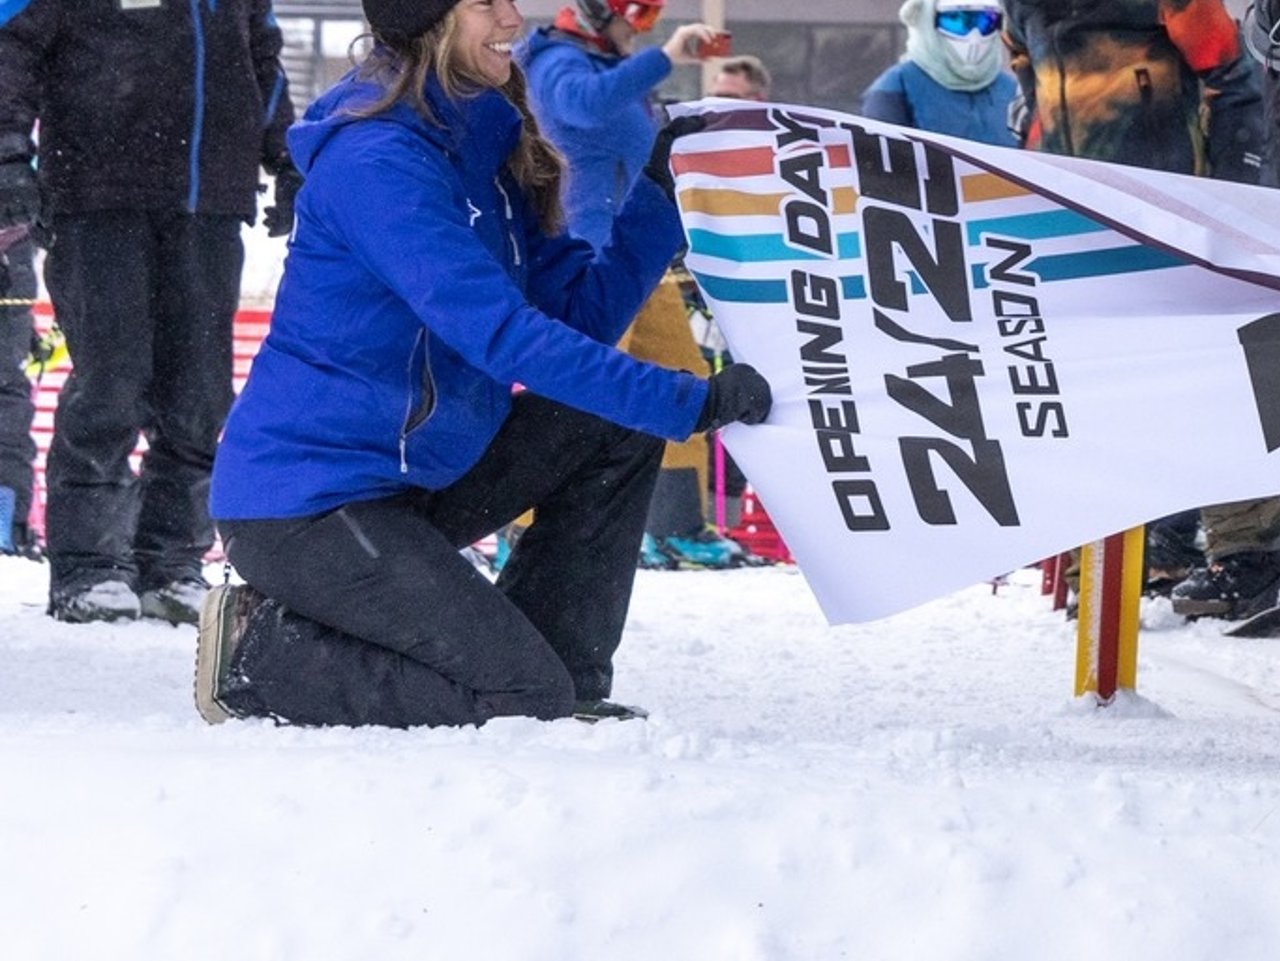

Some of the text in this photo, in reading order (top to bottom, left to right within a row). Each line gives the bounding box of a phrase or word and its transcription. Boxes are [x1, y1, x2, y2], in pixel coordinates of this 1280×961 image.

[772, 108, 891, 532] OPENING DAY
[986, 237, 1069, 438] SEASON
